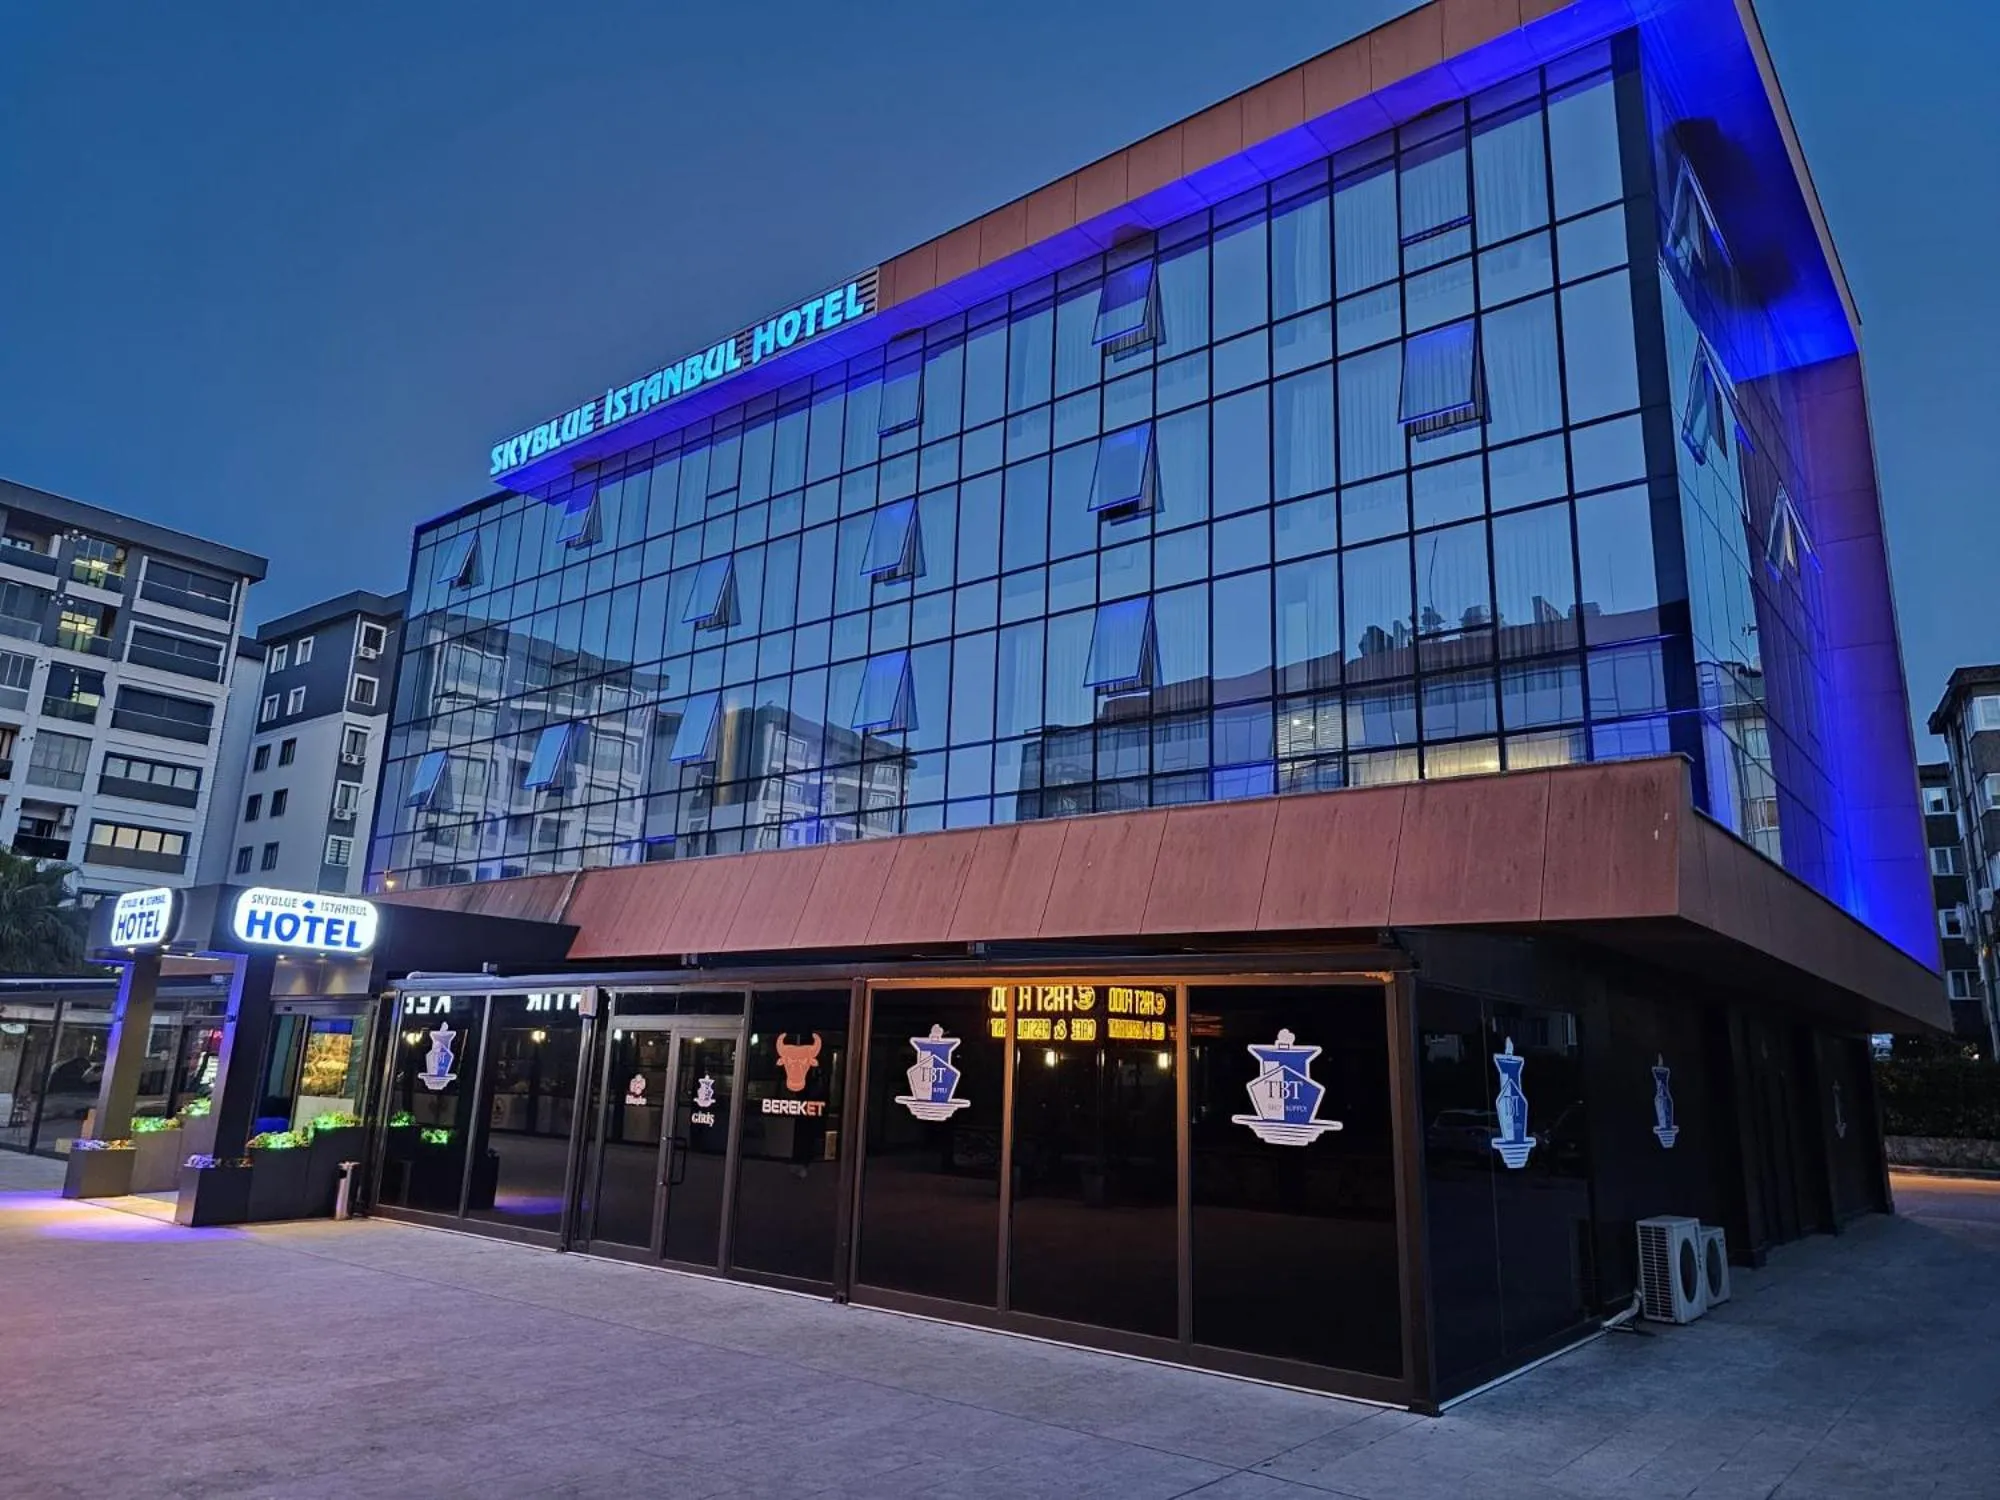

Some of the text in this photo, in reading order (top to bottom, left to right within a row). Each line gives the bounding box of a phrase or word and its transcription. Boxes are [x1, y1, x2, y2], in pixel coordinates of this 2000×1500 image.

[490, 401, 598, 476] SKYBLUE
[751, 282, 864, 363] HOTEL
[251, 893, 298, 909] SKYBLUE
[115, 909, 160, 941] HOTEL
[245, 909, 362, 948] HOTEL
[1264, 1080, 1303, 1099] TBT
[762, 1098, 826, 1116] BEREKET
